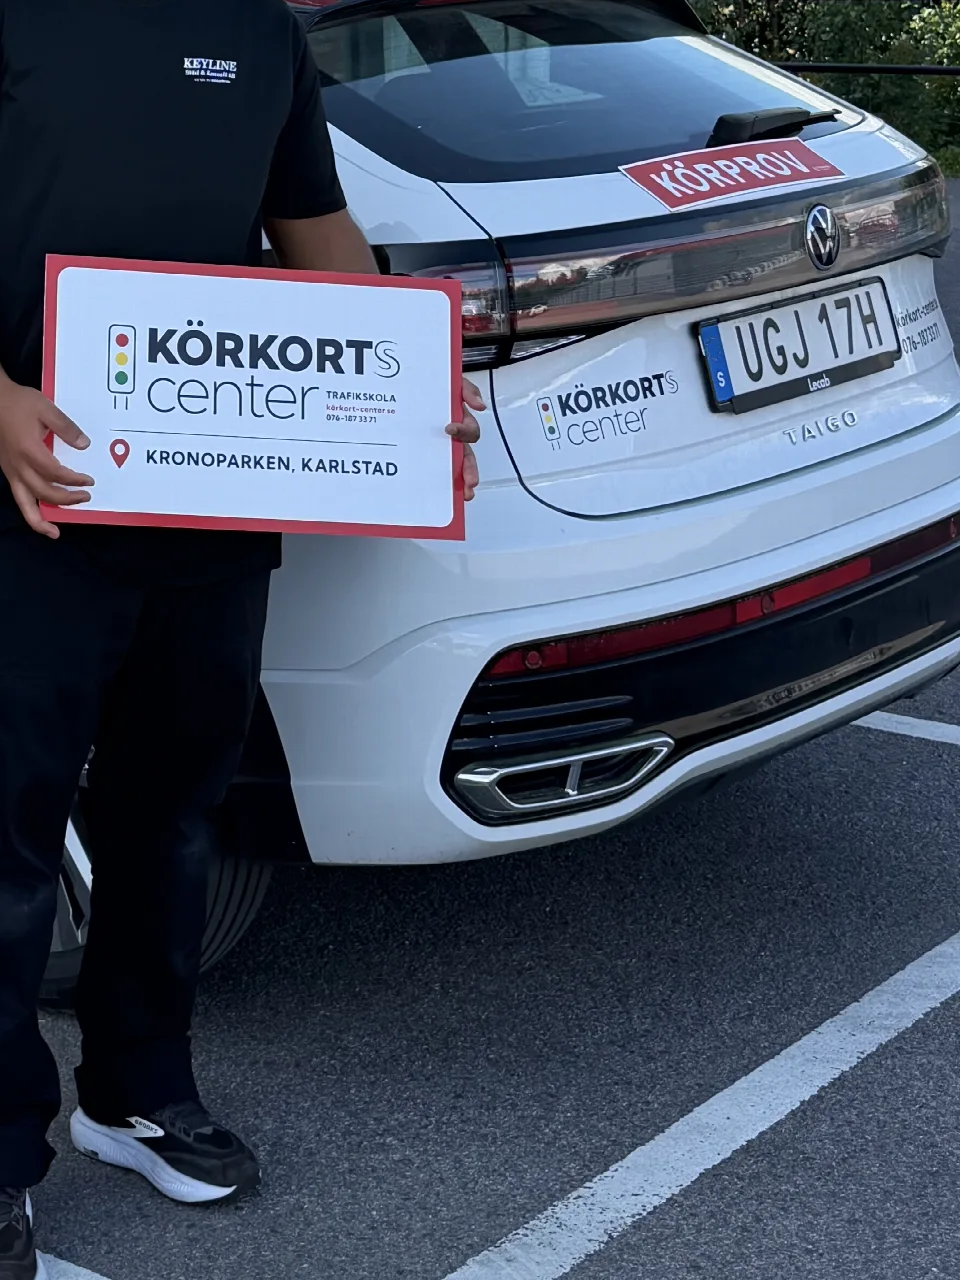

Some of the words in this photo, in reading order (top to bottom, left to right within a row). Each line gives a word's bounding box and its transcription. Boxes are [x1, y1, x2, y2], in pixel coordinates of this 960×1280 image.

[183, 57, 237, 72] KEYLINE
[649, 150, 811, 198] KÖRPROV
[147, 319, 401, 378] KÖRKORTS
[735, 309, 810, 382] UGJ
[817, 290, 884, 359] 17H
[147, 375, 320, 420] center
[326, 390, 397, 403] TRAFIKSKOLA
[557, 369, 679, 417] KÖRKORTS
[716, 371, 726, 387] S
[807, 373, 831, 392] Lecab
[567, 407, 648, 446] center
[783, 409, 858, 445] TAIGO
[146, 449, 296, 474] KRONOPARKEN,
[301, 457, 398, 477] KARLSTAD
